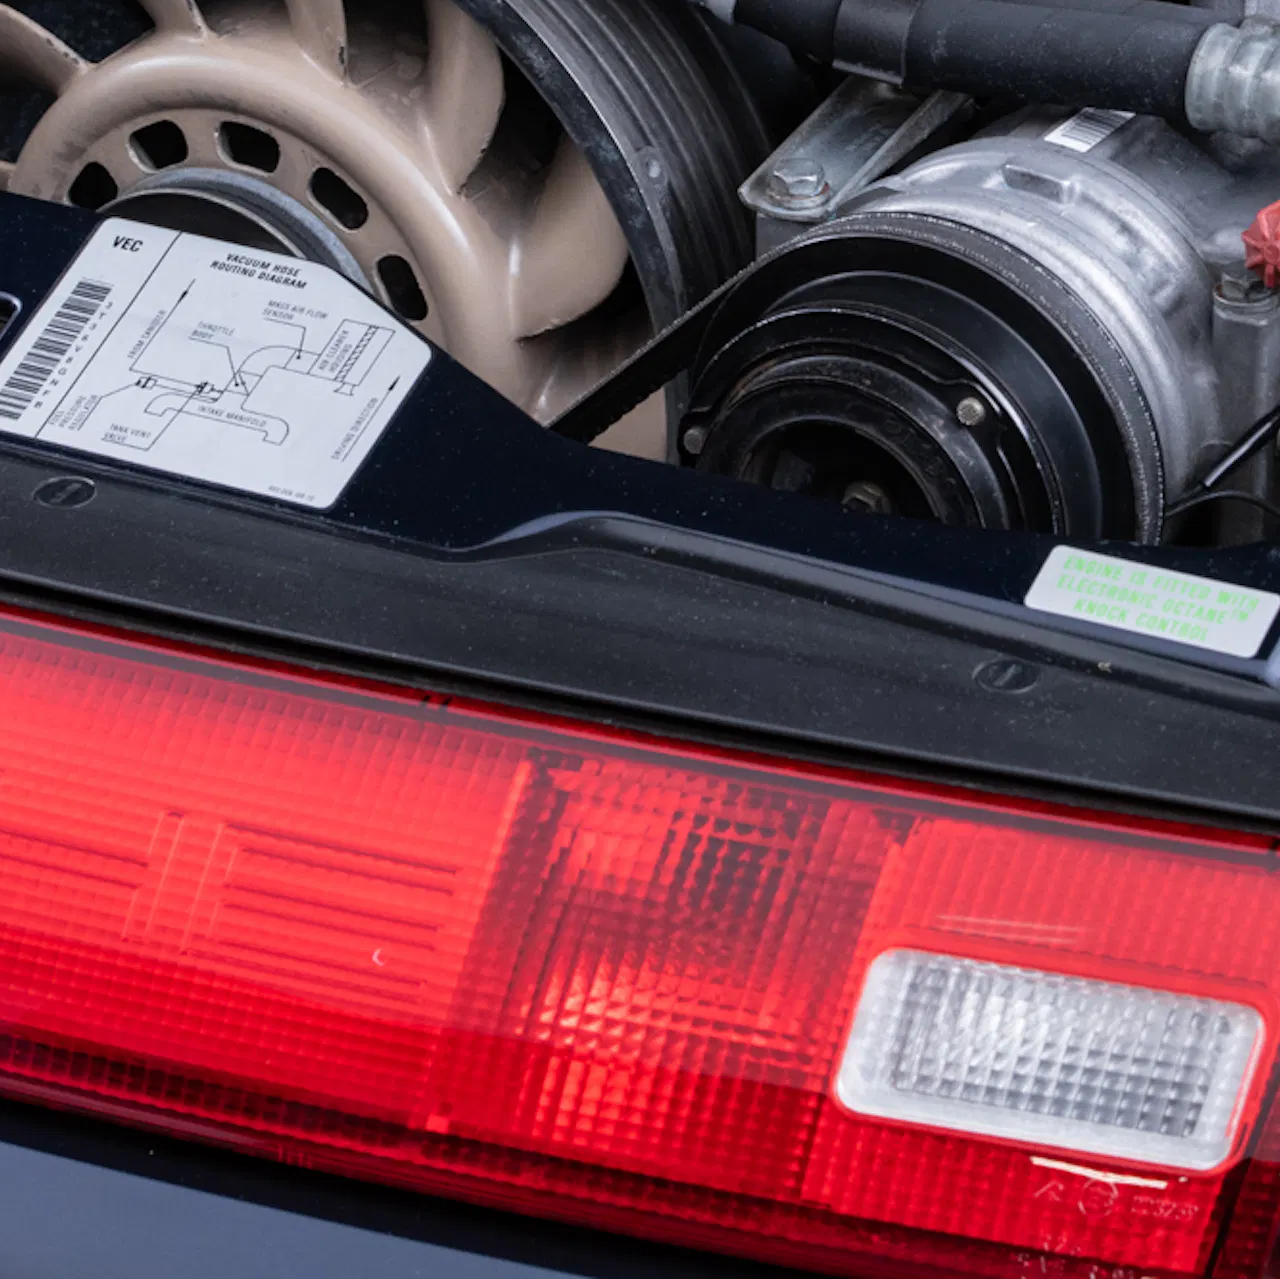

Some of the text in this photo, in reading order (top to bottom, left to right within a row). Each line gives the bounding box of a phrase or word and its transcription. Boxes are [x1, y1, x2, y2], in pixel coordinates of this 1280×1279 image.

[111, 236, 143, 251] VEC
[210, 261, 307, 288] ROUTING DIAGRAM
[225, 253, 299, 275] VACUUM HOSE
[267, 300, 290, 309] MASS
[306, 309, 328, 318] FLOW
[197, 405, 266, 426] INTAKE MANIFOLD
[1057, 574, 1157, 608] ELECTRONIC
[1064, 555, 1258, 611] ENGINE IS FITTED WITH
[1073, 598, 1208, 640] KNOCK CONTROL
